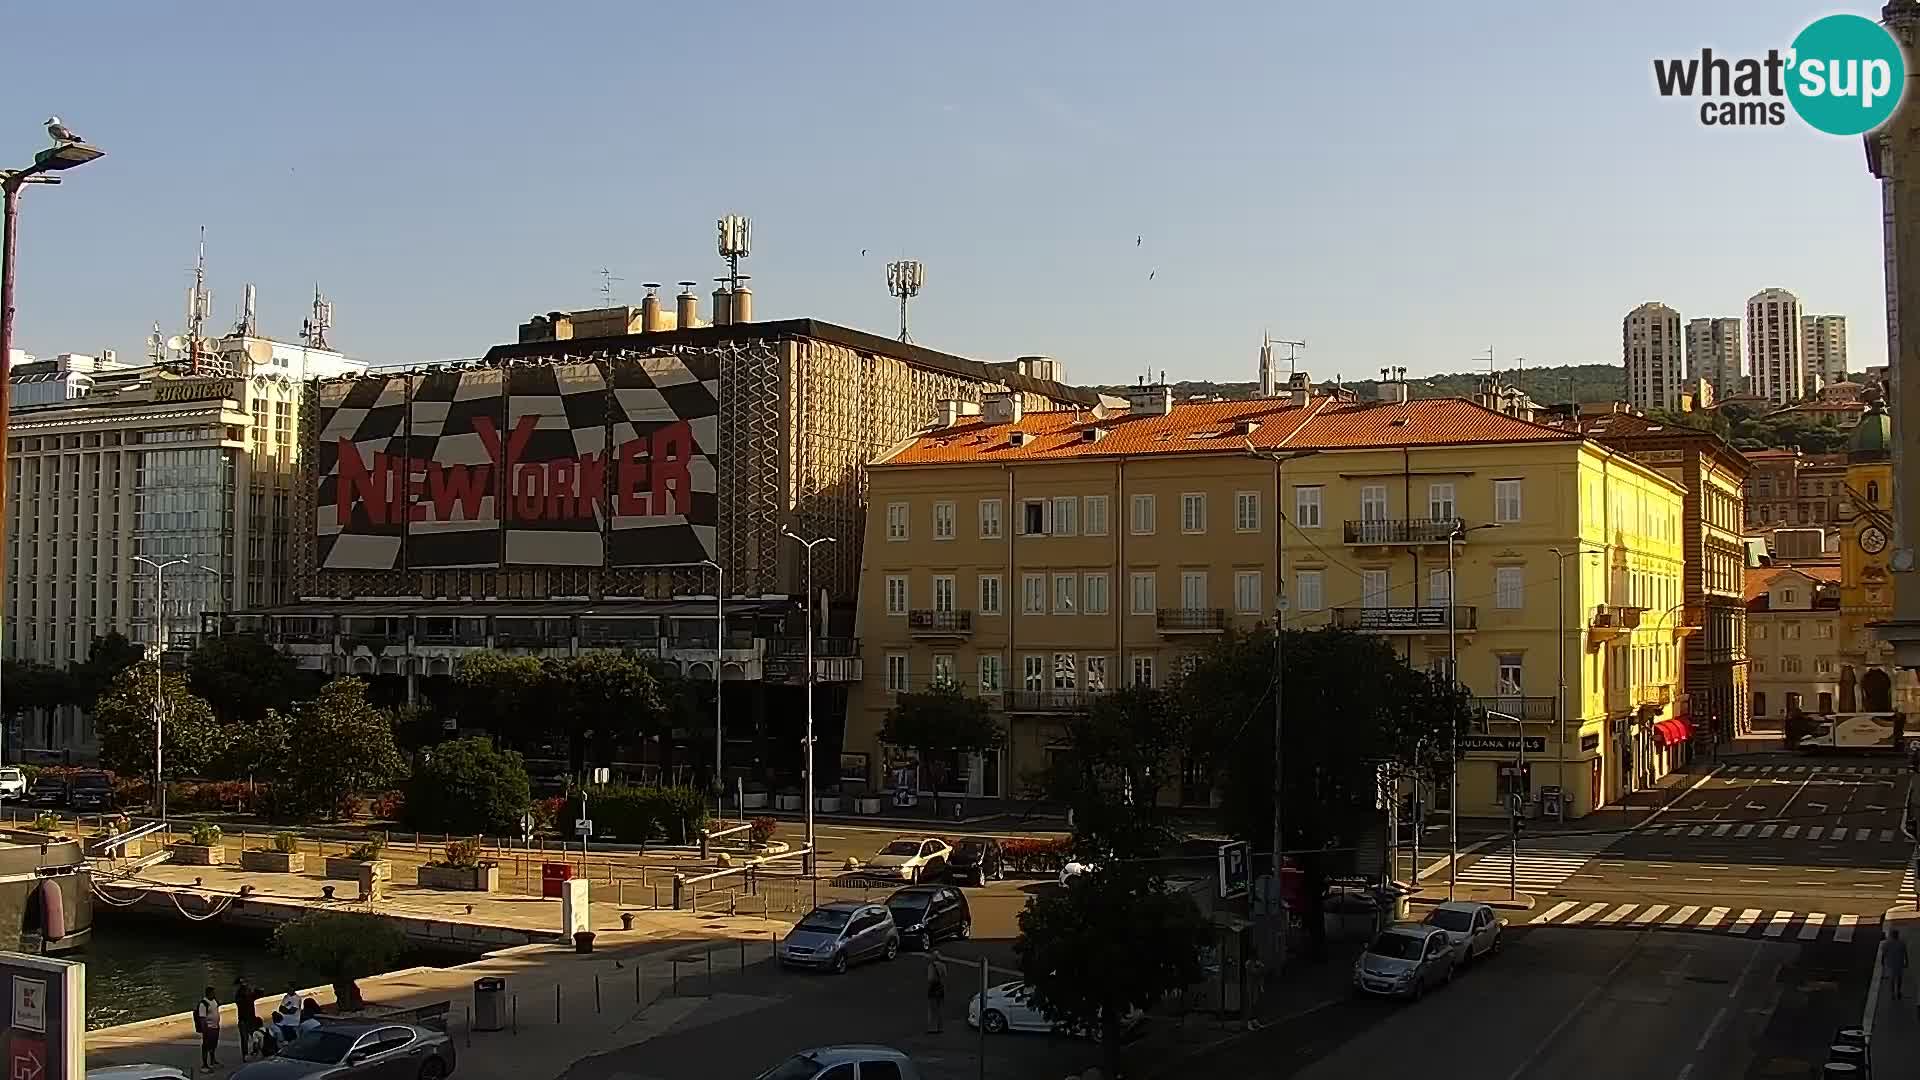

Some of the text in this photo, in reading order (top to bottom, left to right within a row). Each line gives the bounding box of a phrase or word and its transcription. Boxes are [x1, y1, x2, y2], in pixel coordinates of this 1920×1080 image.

[337, 415, 692, 525] NEW YORKER
[1458, 740, 1504, 749] JULIANA
